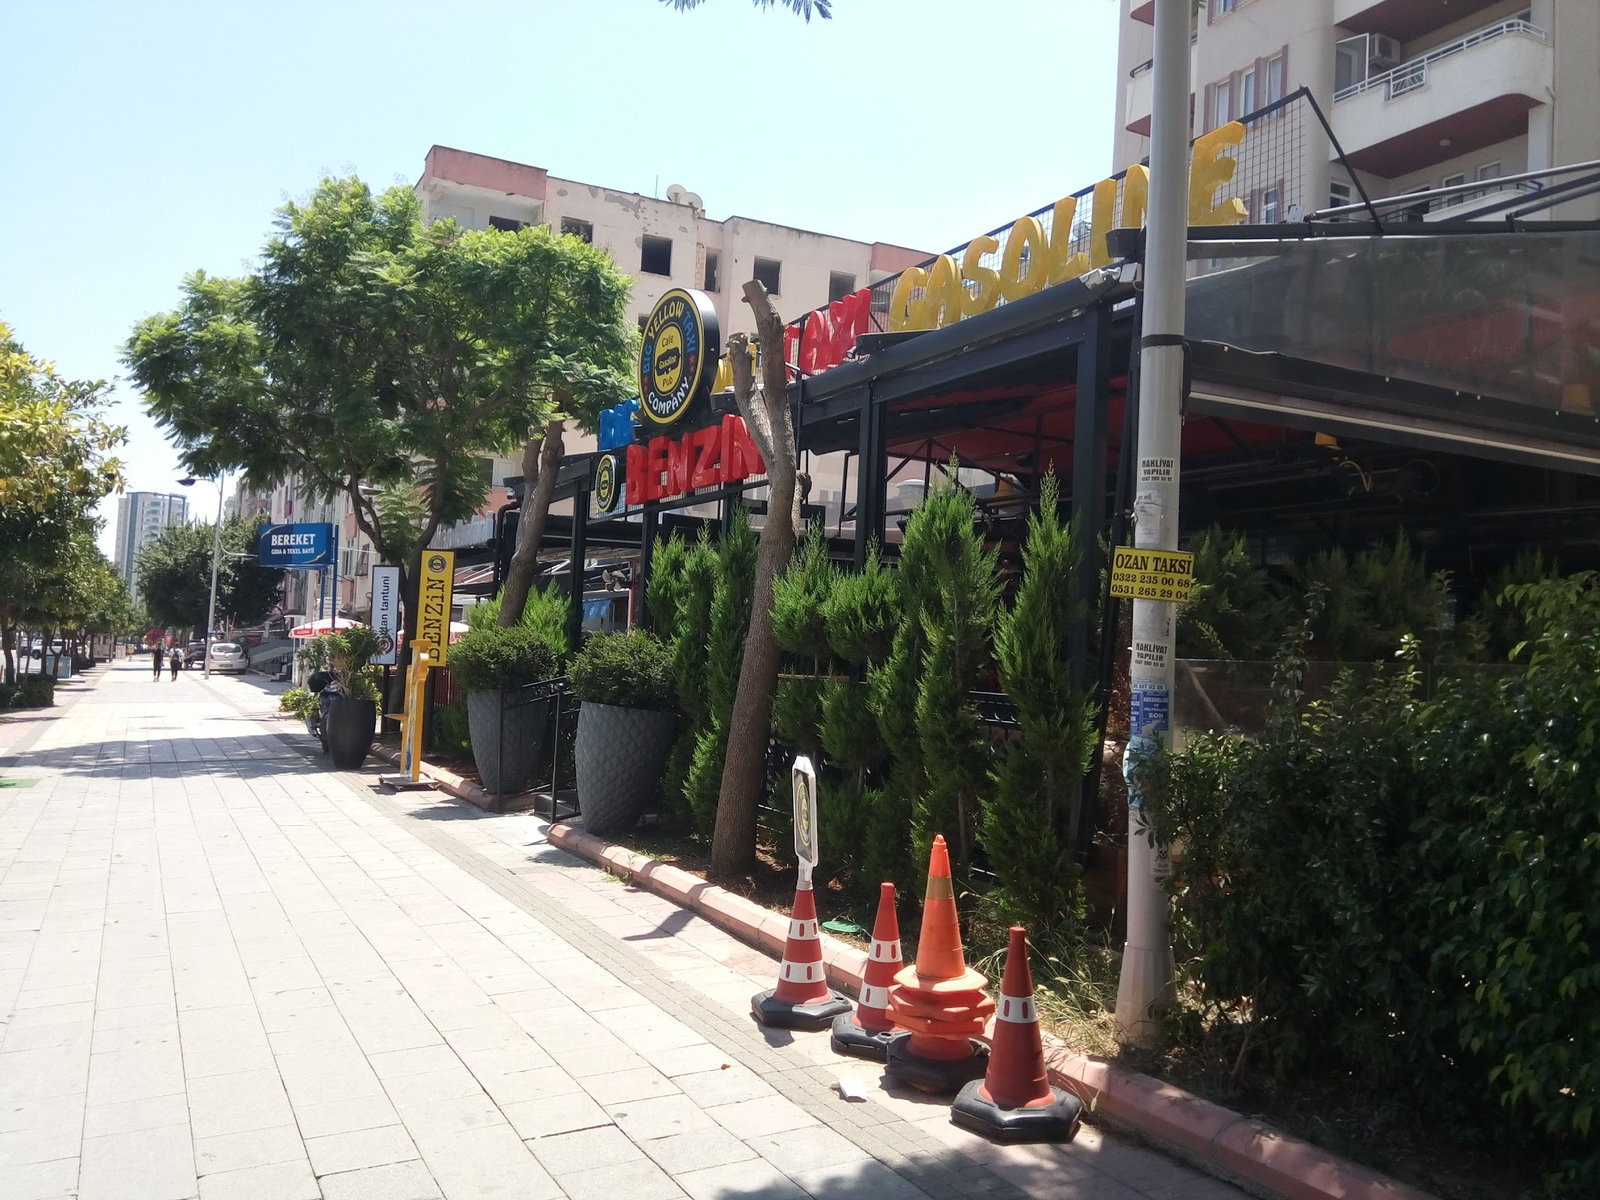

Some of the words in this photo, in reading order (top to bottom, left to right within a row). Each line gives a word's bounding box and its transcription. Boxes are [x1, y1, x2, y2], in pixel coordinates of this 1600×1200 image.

[647, 300, 685, 340] YELLOW
[682, 311, 696, 353] TAXI
[642, 343, 653, 374] BIG
[658, 355, 678, 370] Gasoline
[662, 377, 673, 388] Pub
[1141, 458, 1174, 469] NAKLİYAT
[271, 533, 316, 546] BEREKET
[1116, 553, 1150, 571] OZAN
[1153, 555, 1193, 575] TAKSİ
[1113, 572, 1137, 583] 0322
[1139, 574, 1158, 585] 235
[1161, 577, 1174, 586] 00
[1177, 579, 1190, 588] 68
[379, 575, 390, 612] tantuni
[1111, 584, 1134, 595] 0531
[1138, 586, 1157, 597] 265
[1160, 589, 1173, 598] 29
[1175, 591, 1189, 600] 04
[1136, 642, 1168, 654] NAKLİYAT
[1137, 652, 1163, 661] YAPILIR
